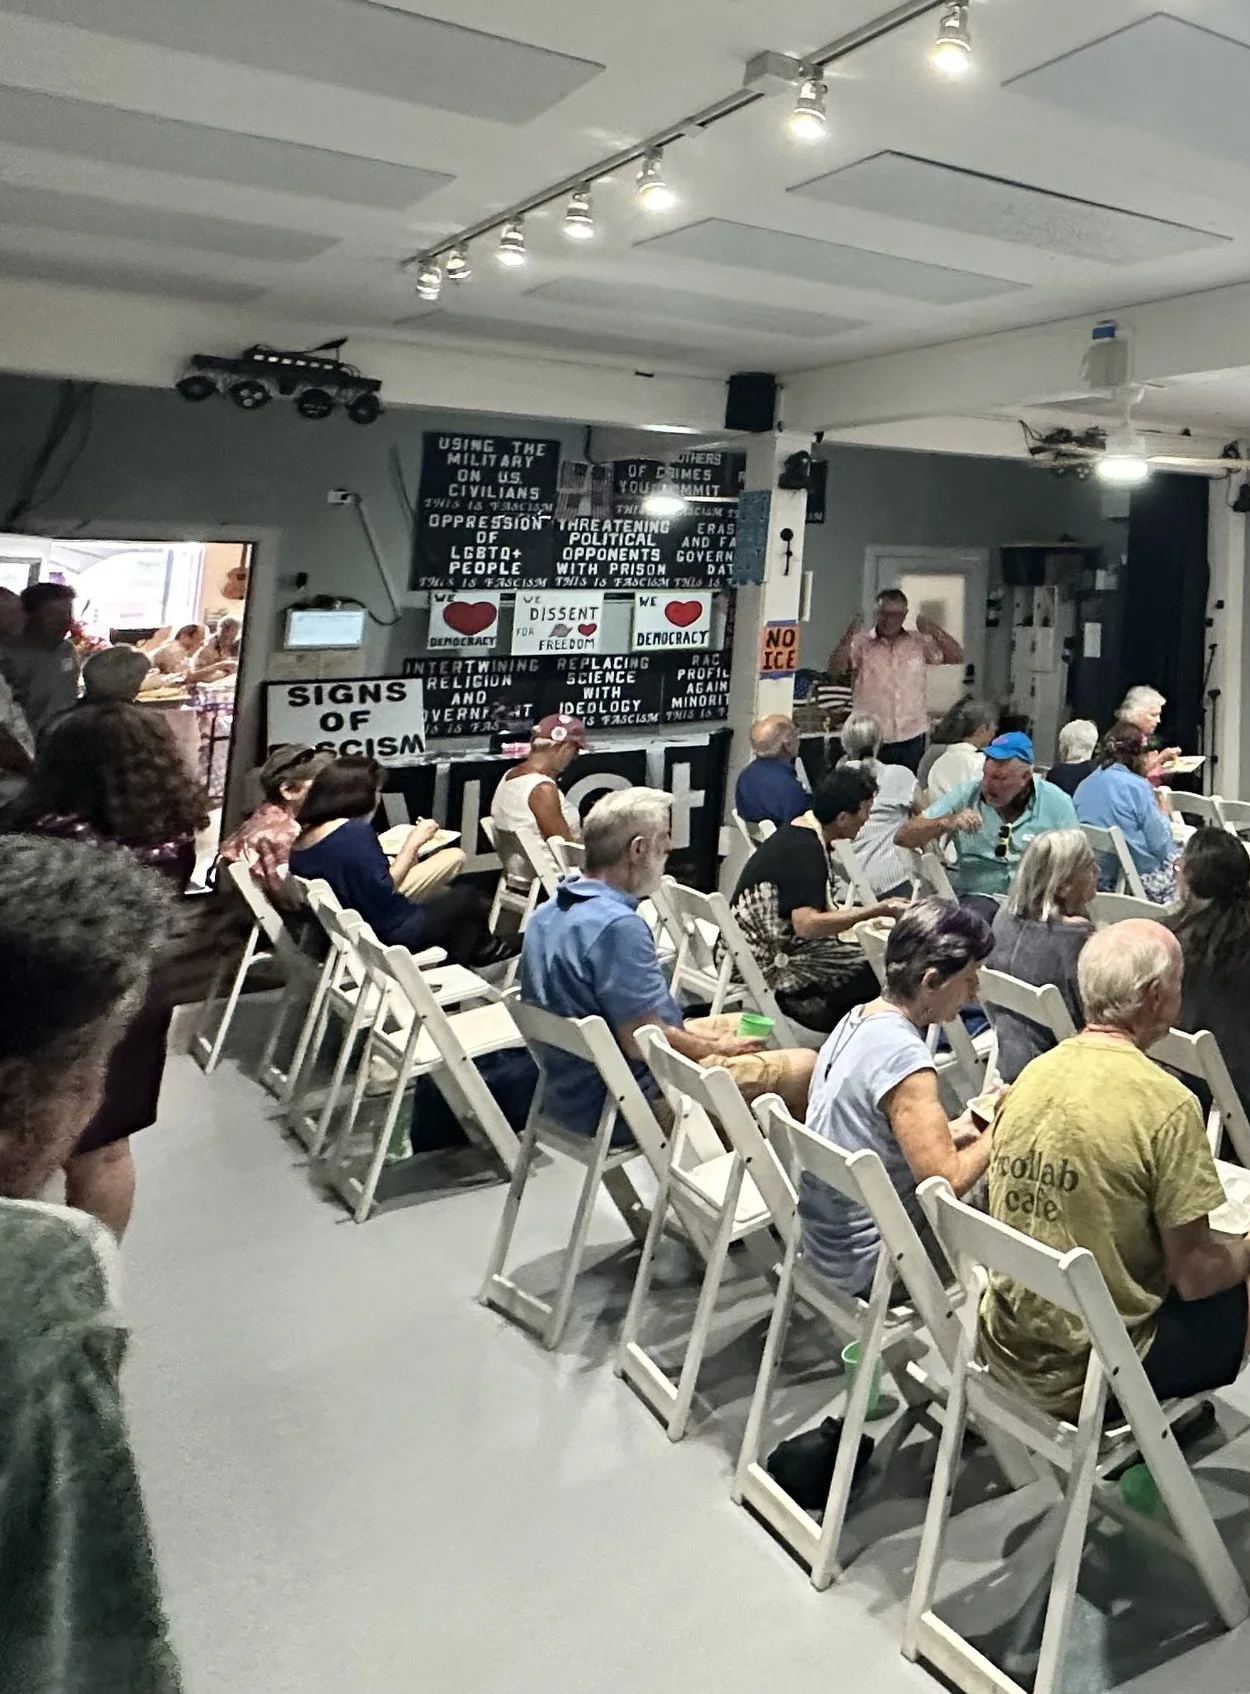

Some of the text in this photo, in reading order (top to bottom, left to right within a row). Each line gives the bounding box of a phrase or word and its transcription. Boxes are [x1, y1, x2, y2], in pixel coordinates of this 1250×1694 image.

[439, 437, 546, 456] USING THE
[447, 453, 534, 468] MILITARY
[457, 469, 480, 482] ON
[628, 464, 646, 478] OF
[448, 484, 540, 500] CIVILIANS
[619, 480, 650, 495] YOU
[424, 499, 553, 512] THIS IS FASCISM
[429, 514, 542, 530] OPPRESSION
[559, 518, 670, 534] THREATENING
[697, 523, 735, 535] ERAS
[476, 531, 498, 544] OF
[569, 532, 657, 547] POLITICAL
[681, 536, 737, 548] AND FA
[451, 546, 522, 560] LGBTQ+
[562, 547, 660, 562] OPPONENTS
[676, 550, 733, 562] GOVERN
[449, 561, 521, 575] PEOPLE
[556, 562, 666, 576] WITH PRISON
[707, 564, 734, 576] DAT
[419, 576, 549, 588] THIS IS FASCISM
[555, 576, 669, 588] THIS IS FASCISM
[674, 577, 702, 588] THIS
[709, 577, 720, 588] IS
[435, 594, 456, 603] WE
[639, 596, 657, 607] WE
[530, 606, 599, 622] DISSENT
[517, 627, 535, 637] FOR
[637, 630, 710, 647] DEMOCRACY
[765, 628, 796, 649] NO
[430, 636, 497, 648] DEMOCRACY
[538, 638, 595, 651] FREEDOM
[405, 658, 539, 675] INTERTWINING
[557, 656, 650, 671] REPLACING
[692, 653, 720, 666] RAC
[762, 649, 796, 671] ICE
[566, 670, 637, 685] SCIENCE
[677, 667, 730, 681] PROFIL
[427, 674, 512, 691] RELIGION
[686, 680, 728, 695] AGAIN
[287, 681, 407, 707] SIGNS
[451, 690, 486, 706] AND
[583, 686, 621, 700] WITH
[559, 699, 641, 714] IDEOLOGY
[671, 692, 730, 709] MINORIT
[319, 709, 371, 733] OF
[601, 711, 659, 725] FASCISM
[666, 707, 694, 721] THIS
[700, 707, 712, 719] IS
